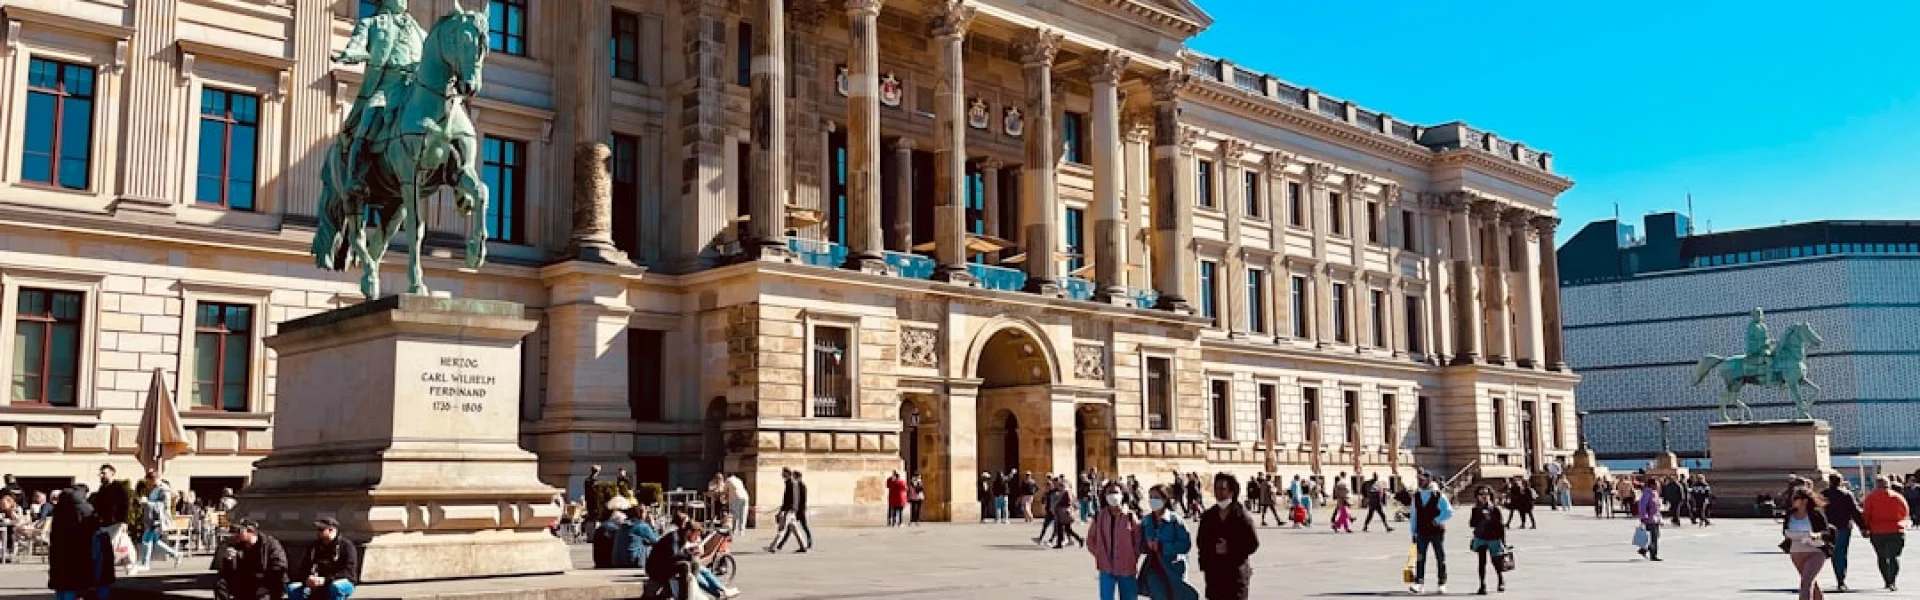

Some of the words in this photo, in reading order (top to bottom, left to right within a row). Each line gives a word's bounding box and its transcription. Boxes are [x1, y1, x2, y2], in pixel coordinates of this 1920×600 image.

[440, 357, 478, 368] HERZOG
[421, 373, 448, 382] CARL
[451, 374, 495, 385] WILHELM
[429, 386, 486, 397] FERDINAND
